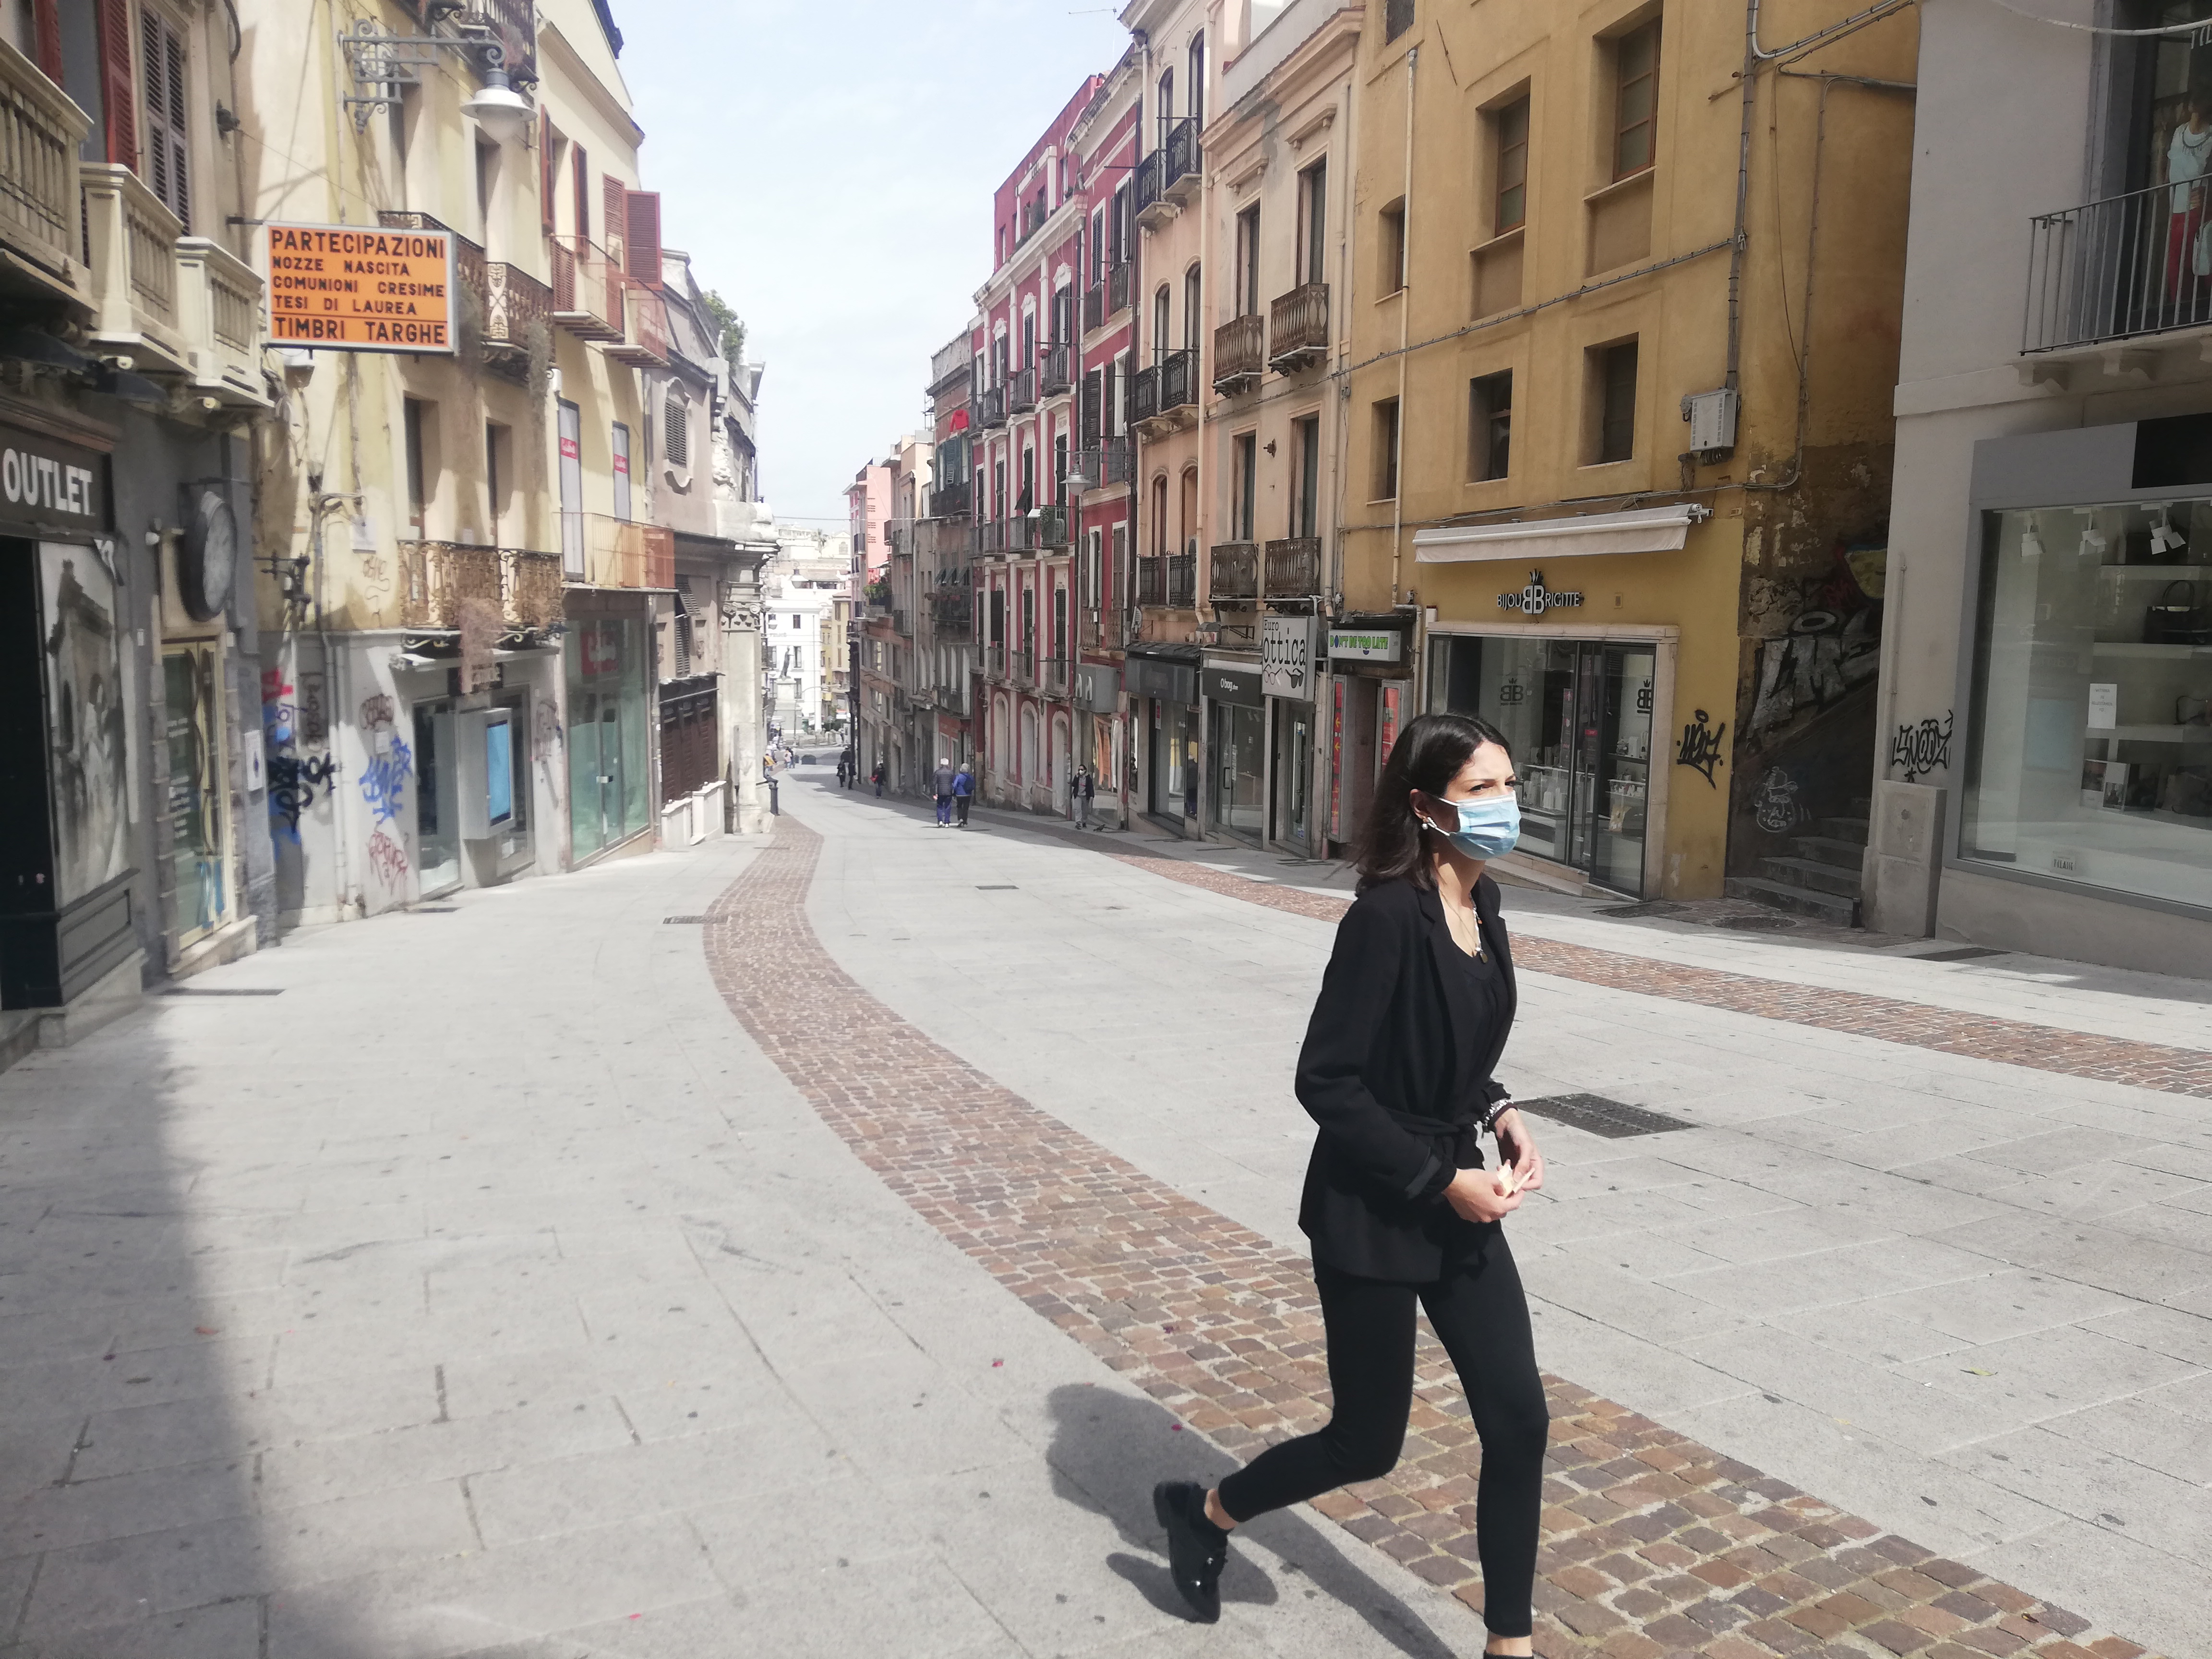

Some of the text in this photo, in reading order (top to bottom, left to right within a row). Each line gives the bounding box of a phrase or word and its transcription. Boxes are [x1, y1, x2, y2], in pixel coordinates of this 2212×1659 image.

[271, 229, 445, 259] PARTECIPAZIONI
[272, 256, 410, 276] NOZZE NASCITA
[273, 276, 445, 297] COMUNIONI CRESIME
[274, 295, 417, 315] TESI DI LAUREA
[275, 317, 445, 344] TIMBRI TARGHE
[3, 448, 93, 516] OUTLET
[1497, 593, 1522, 611] BIJOU
[1263, 620, 1279, 631] Euro
[1263, 627, 1306, 666] ottica
[1358, 636, 1371, 649] TOO
[1372, 637, 1388, 649] LATE
